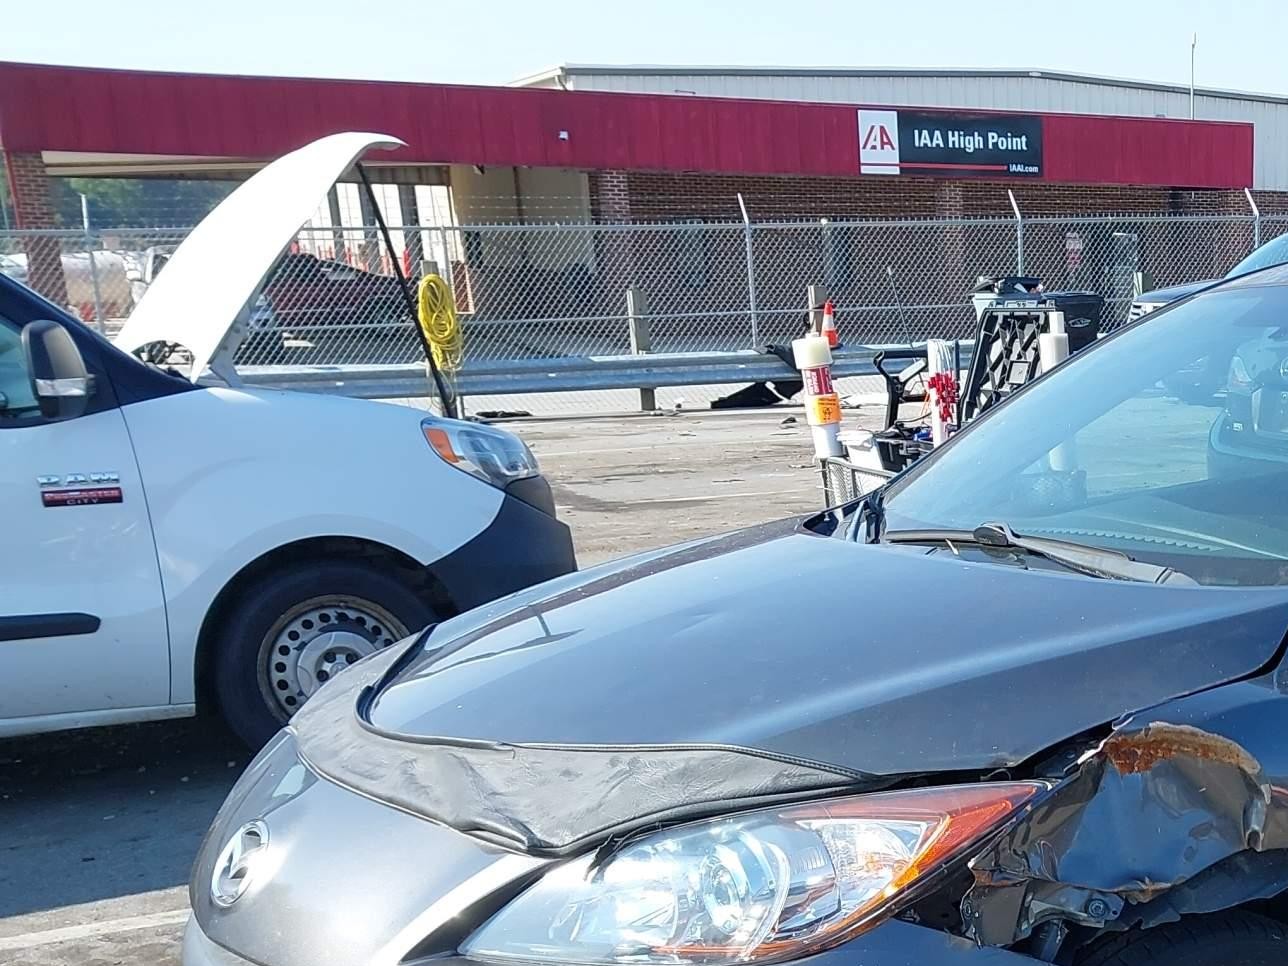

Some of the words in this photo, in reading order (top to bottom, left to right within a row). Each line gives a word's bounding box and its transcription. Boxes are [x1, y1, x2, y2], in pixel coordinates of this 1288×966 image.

[914, 129, 944, 148] IAA
[948, 131, 984, 153] High
[988, 132, 1027, 150] Point
